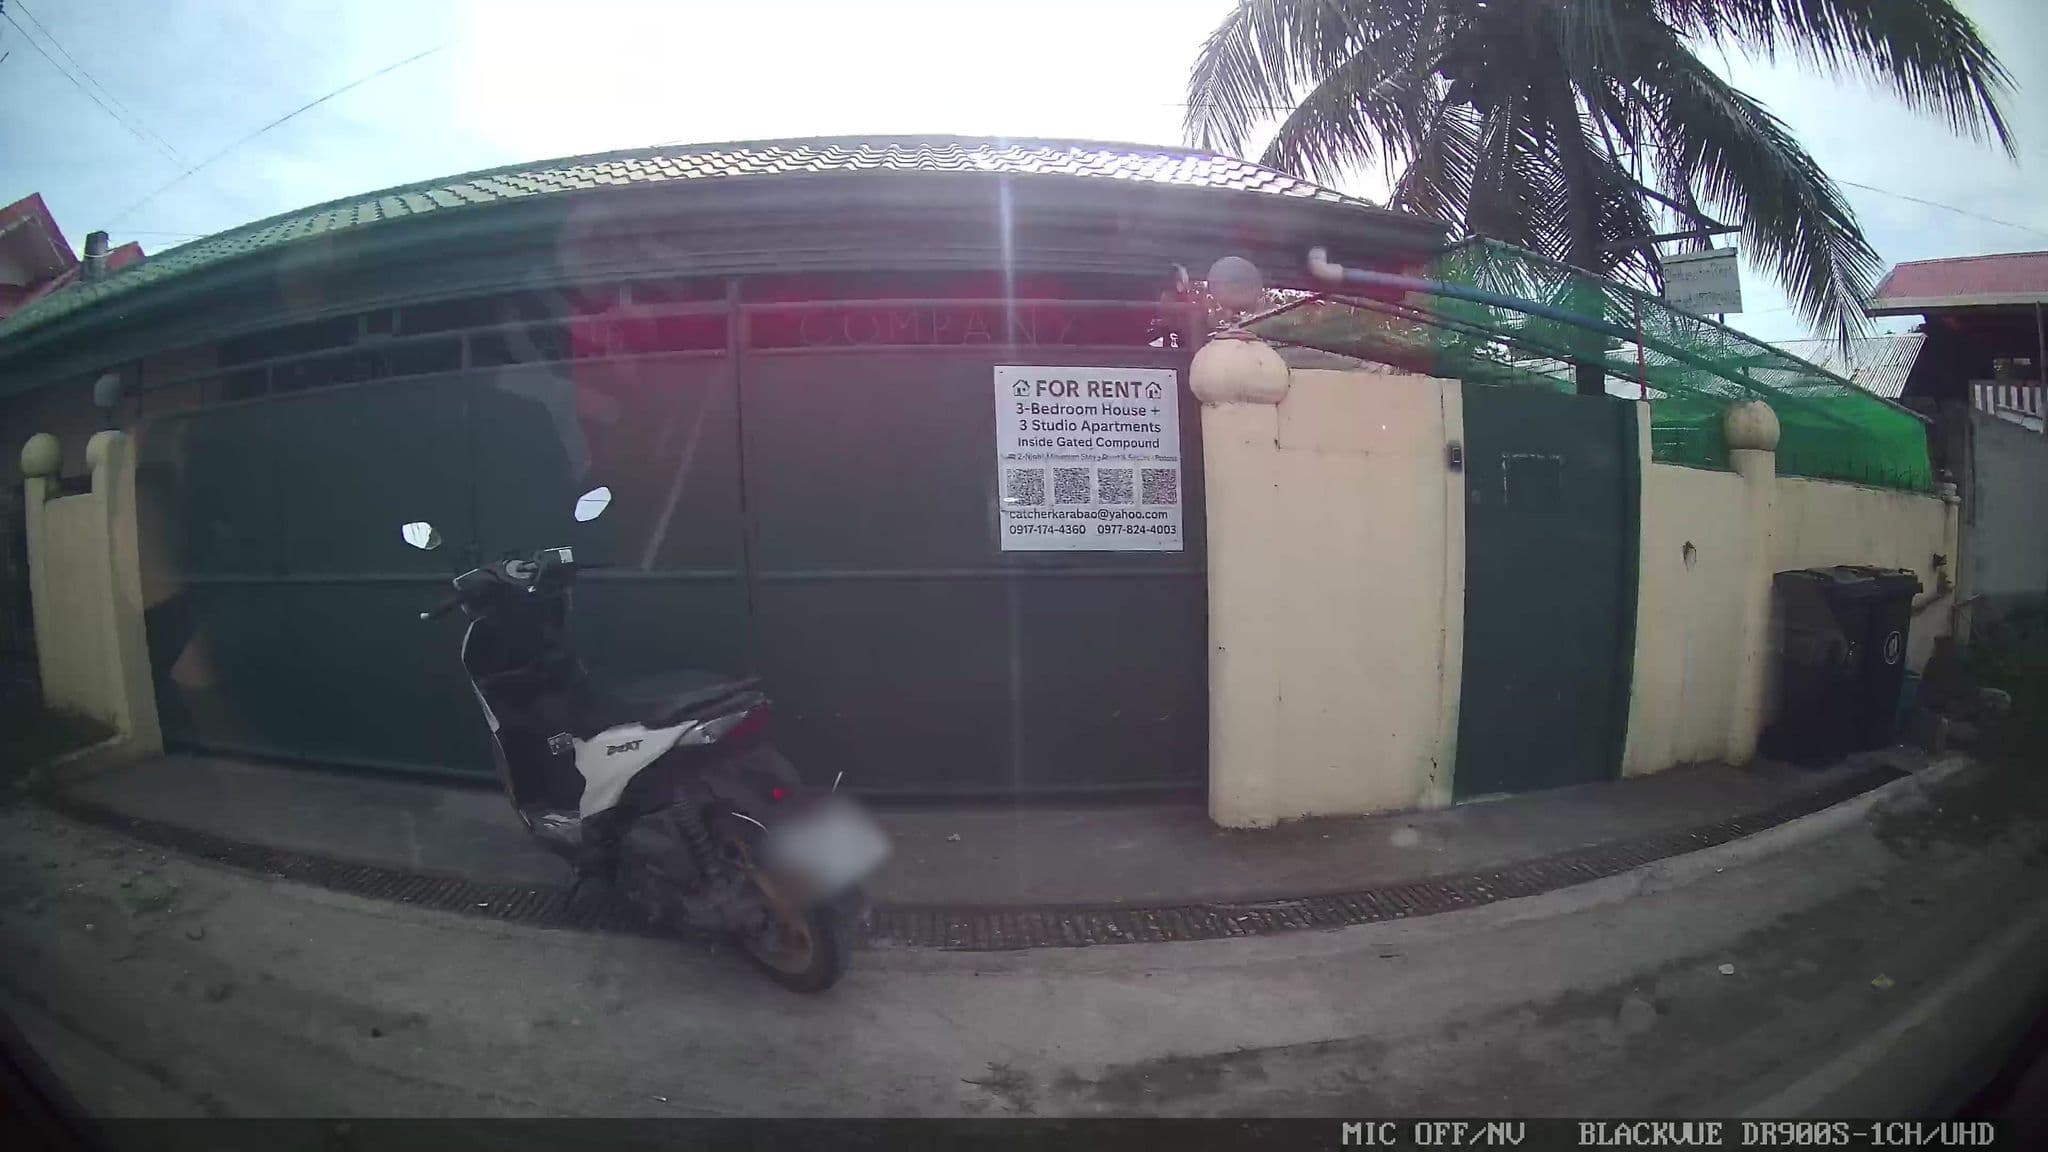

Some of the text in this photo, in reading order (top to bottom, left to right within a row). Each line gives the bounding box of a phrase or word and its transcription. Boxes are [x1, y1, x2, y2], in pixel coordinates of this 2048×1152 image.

[1036, 380, 1142, 399] FOR RENT
[1016, 402, 1160, 416] 3-Bedroom House +
[1019, 419, 1162, 434] 3 Studio Apartments
[1018, 436, 1160, 449] Inside Gated Compound
[1009, 509, 1168, 521] catcherkarabao@yahoo.com
[1009, 524, 1177, 535] 0917-174-4360 0977-824-4003
